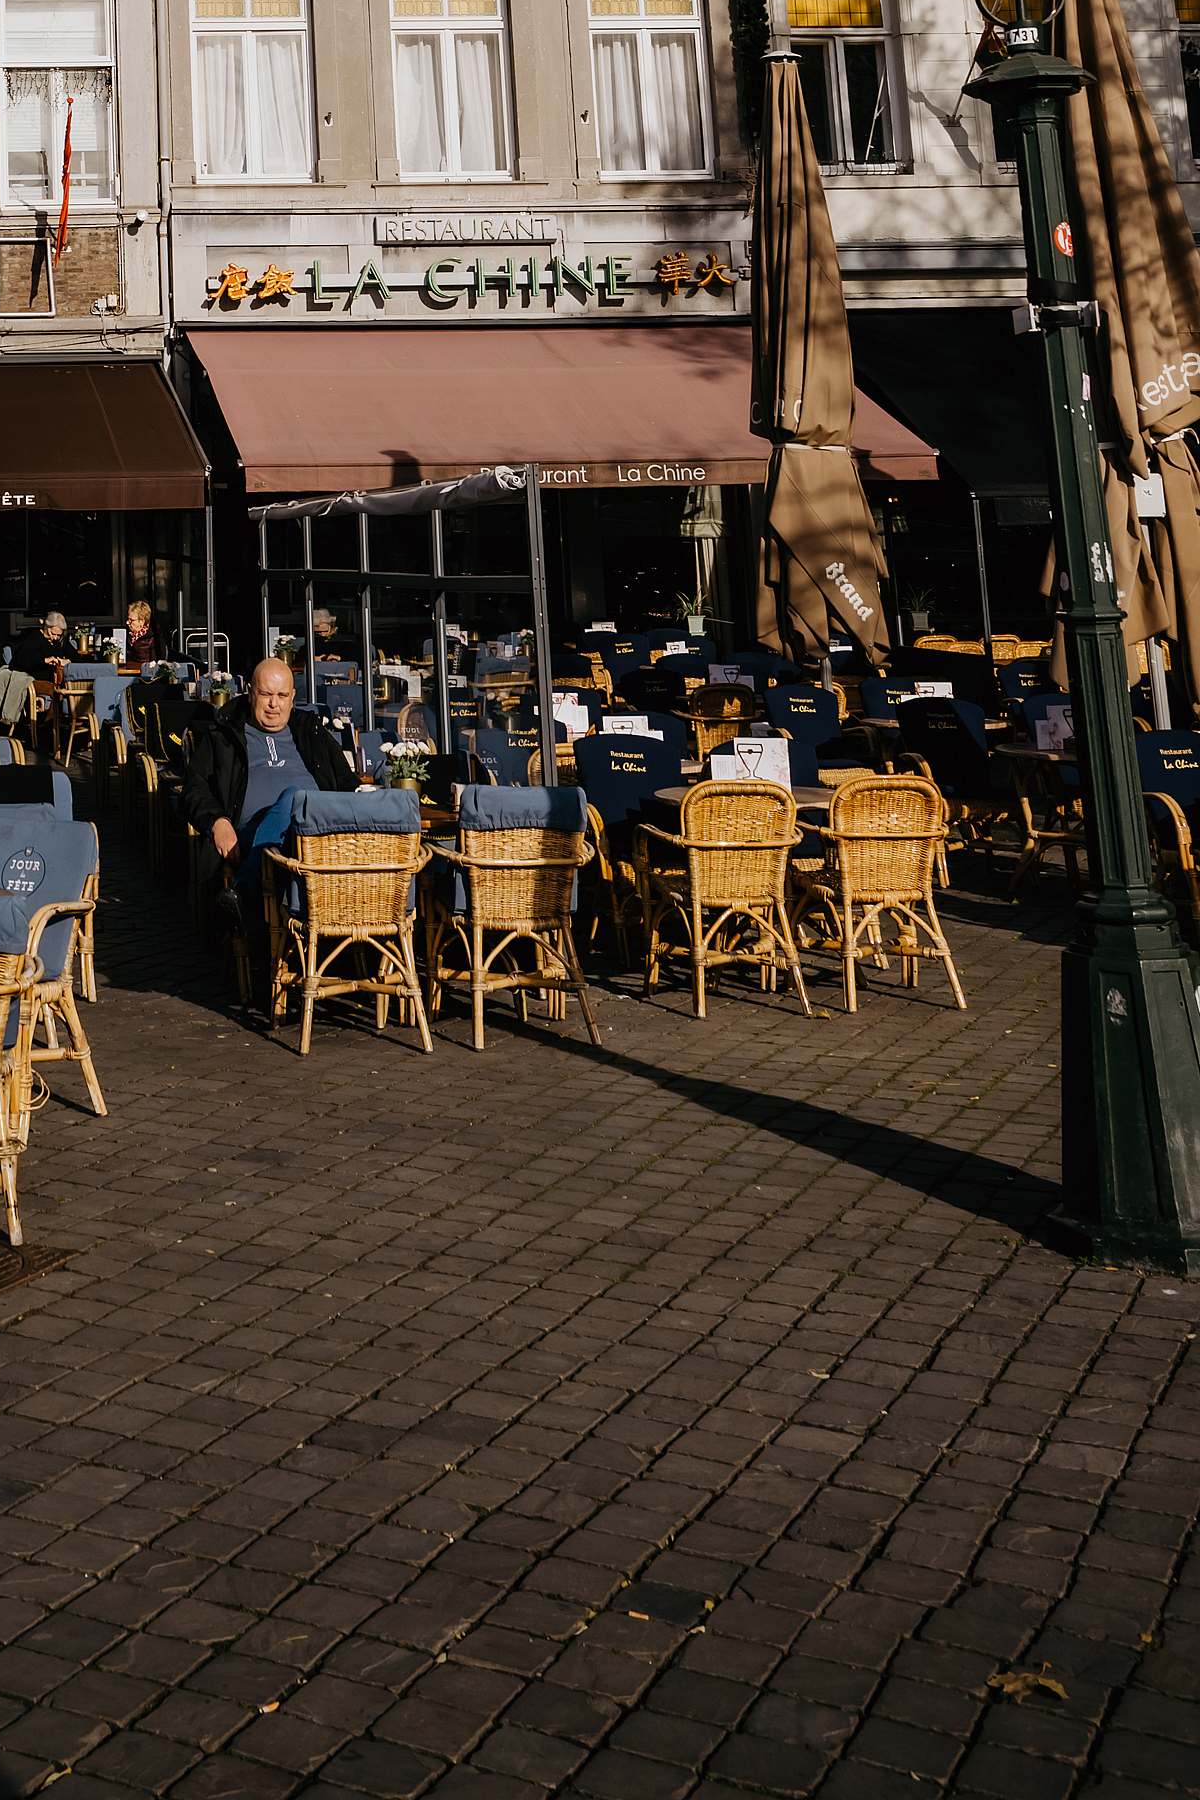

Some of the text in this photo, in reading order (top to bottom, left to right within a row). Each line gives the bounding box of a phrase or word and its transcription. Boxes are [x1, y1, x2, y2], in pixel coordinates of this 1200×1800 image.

[385, 218, 550, 242] RESTAURANT
[312, 256, 635, 303] LA CHINE
[617, 464, 641, 482] La
[647, 463, 706, 482] Chine
[9, 859, 41, 872] JOUR
[6, 879, 36, 892] FÊTE
